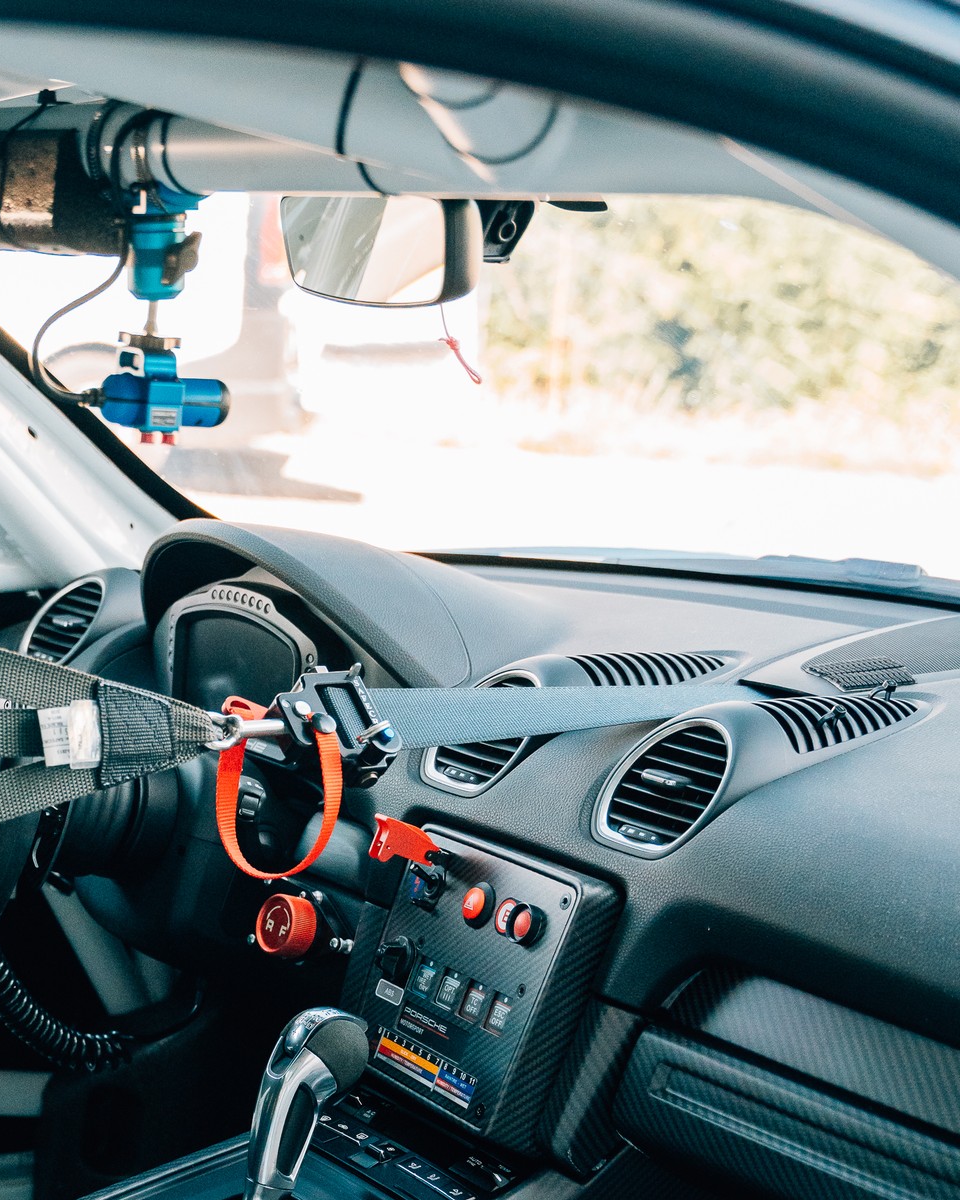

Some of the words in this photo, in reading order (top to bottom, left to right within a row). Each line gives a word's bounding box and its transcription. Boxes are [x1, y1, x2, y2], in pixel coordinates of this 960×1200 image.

[471, 996, 478, 1005] TC
[494, 1008, 505, 1019] ESC
[404, 1006, 448, 1034] PORSCHE
[491, 1017, 503, 1027] OFF
